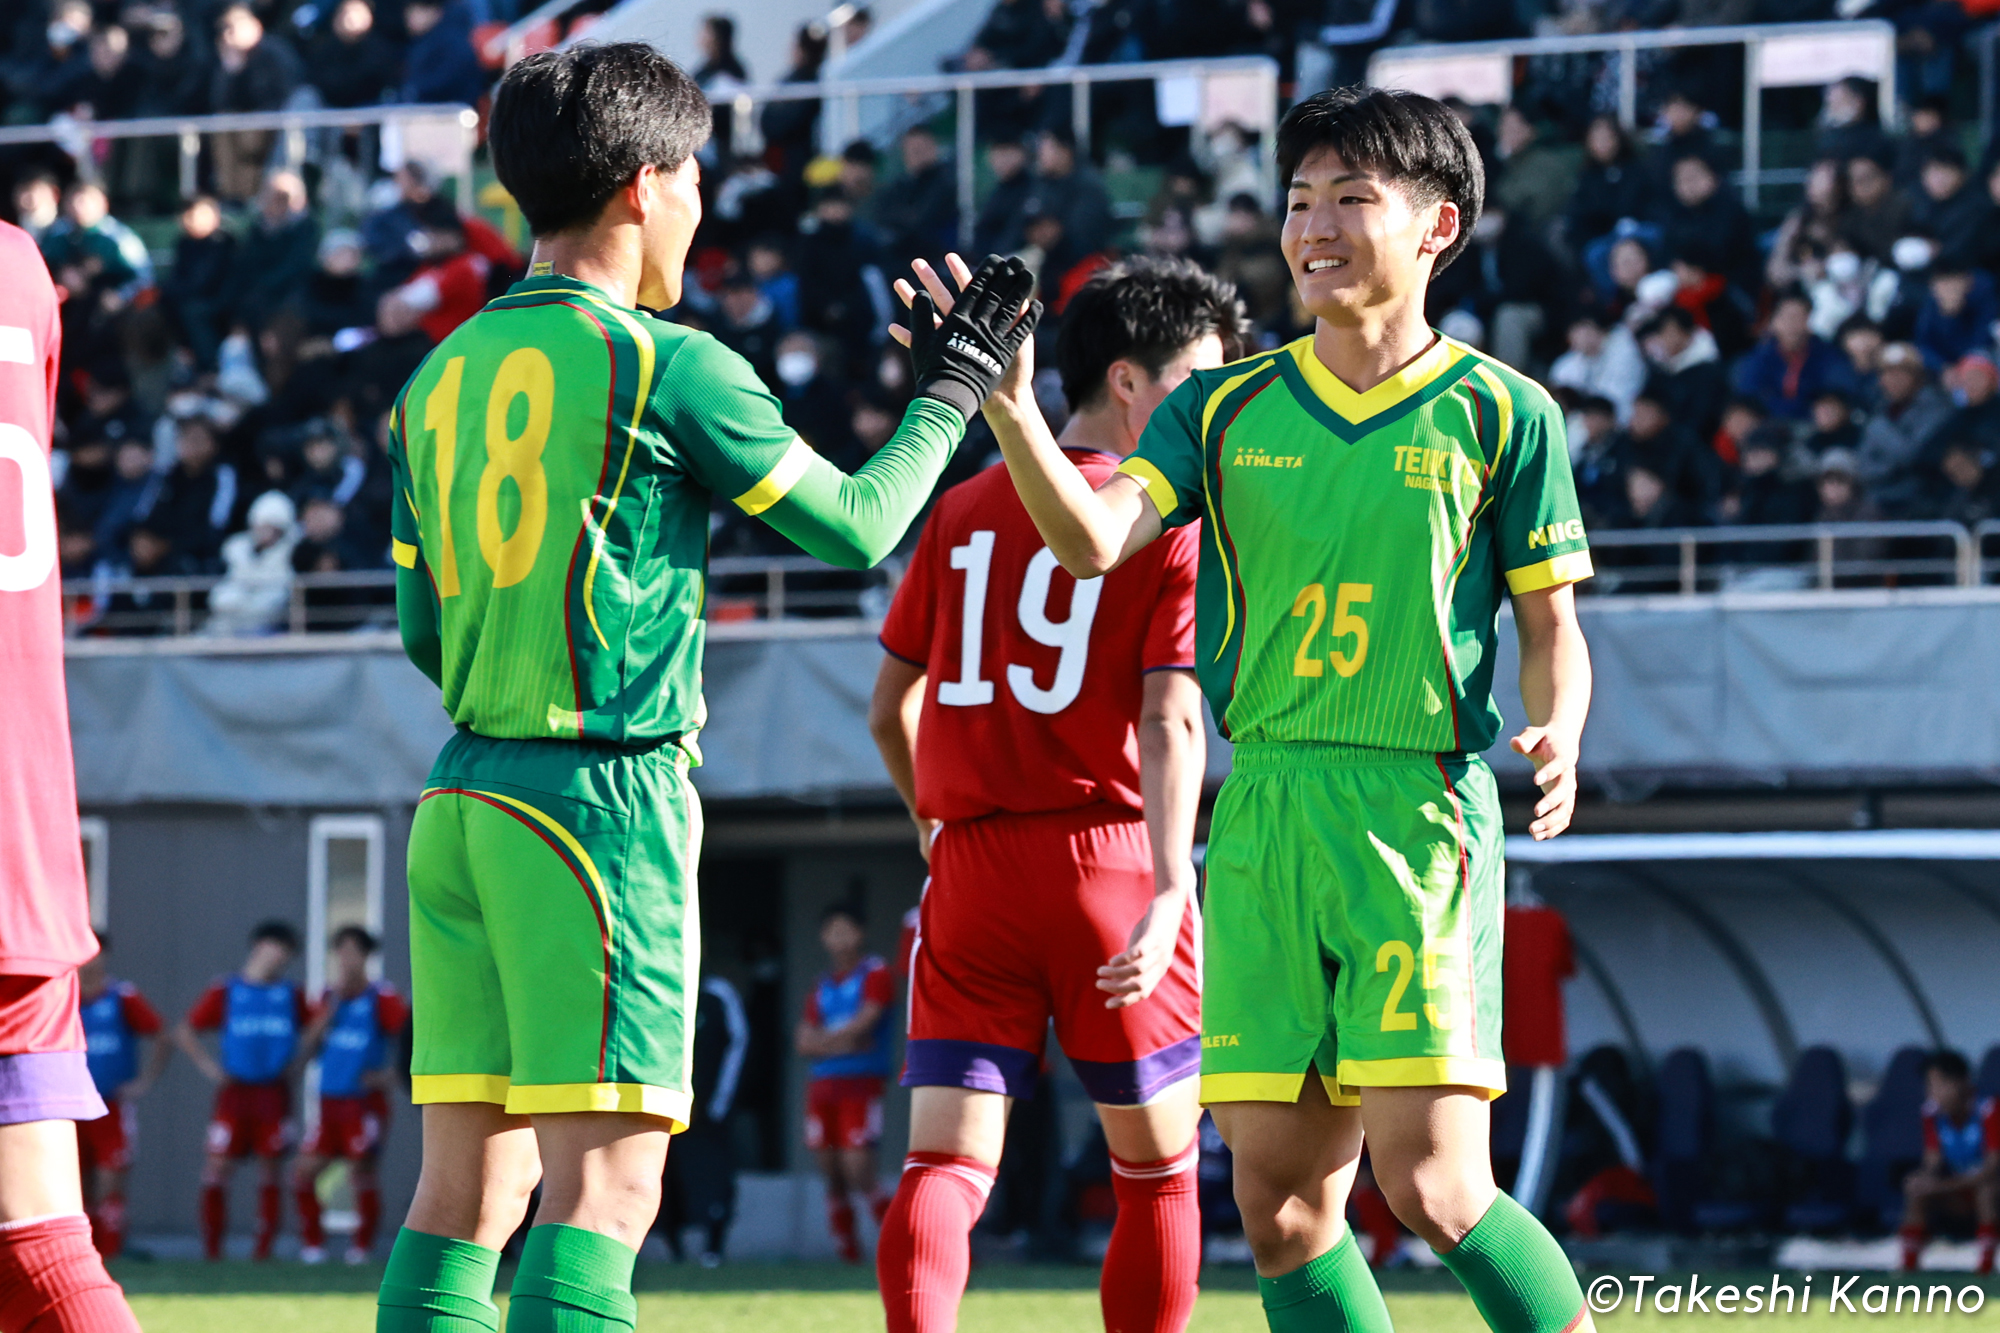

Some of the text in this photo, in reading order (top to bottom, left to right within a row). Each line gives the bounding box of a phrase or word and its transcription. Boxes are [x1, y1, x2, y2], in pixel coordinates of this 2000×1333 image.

[946, 337, 1002, 376] ATHLETA
[424, 347, 555, 599] 18
[1233, 454, 1303, 468] ATHLETA
[1528, 518, 1587, 550] NIIG
[937, 530, 1105, 715] 19
[1291, 582, 1373, 678] 25
[1376, 936, 1462, 1032] 25
